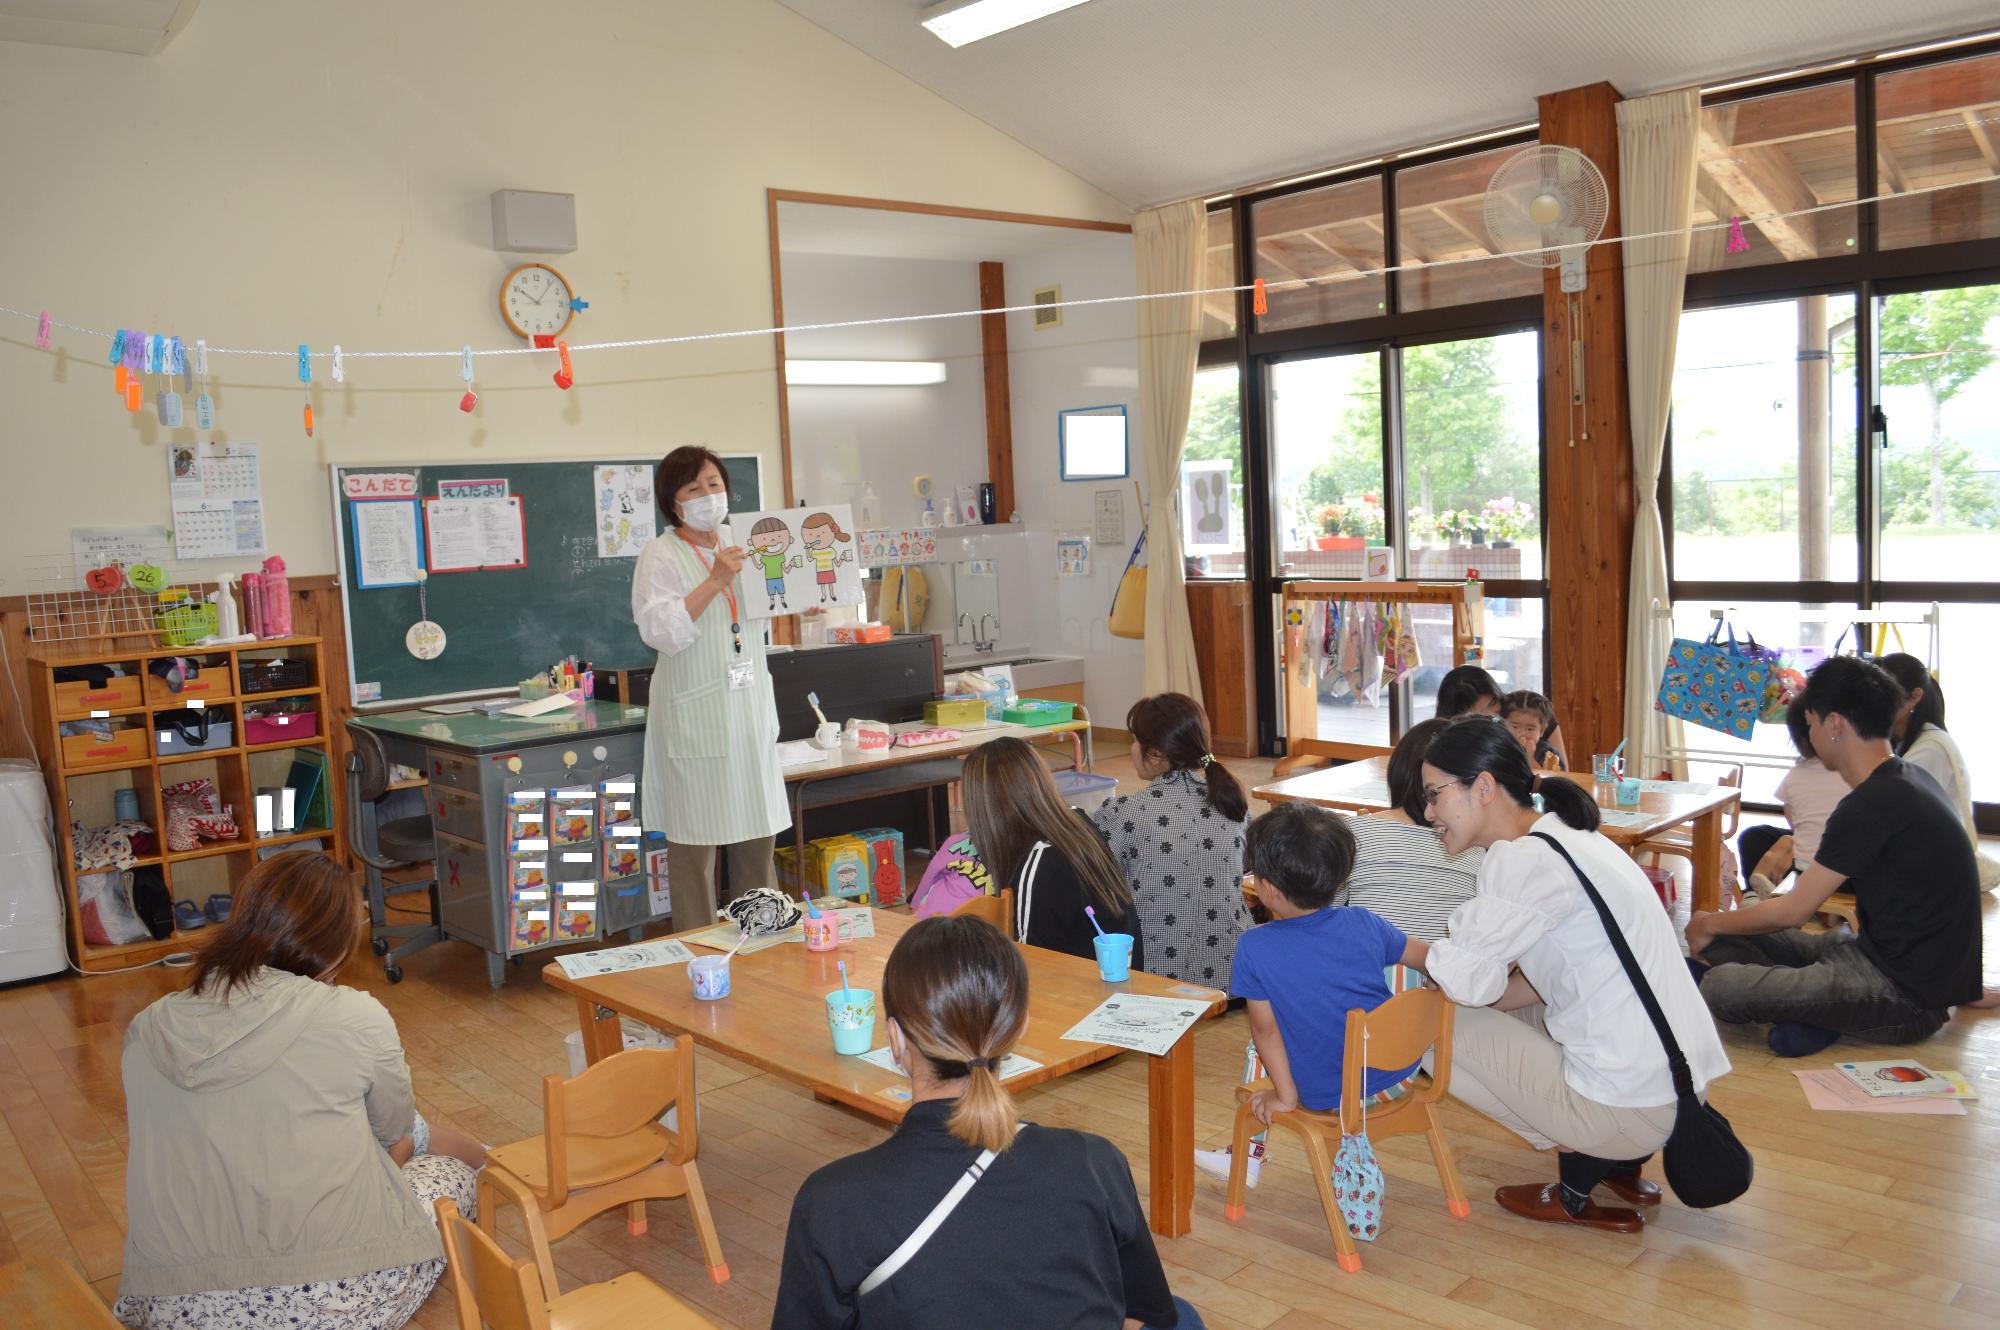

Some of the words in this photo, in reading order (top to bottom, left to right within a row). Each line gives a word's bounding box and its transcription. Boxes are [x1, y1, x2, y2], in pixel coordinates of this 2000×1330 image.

[533, 274, 540, 282] 12
[225, 447, 231, 455] 5
[349, 478, 413, 493] こんだて
[443, 484, 505, 498] えんだより
[94, 573, 107, 588] 5
[136, 570, 155, 583] 26
